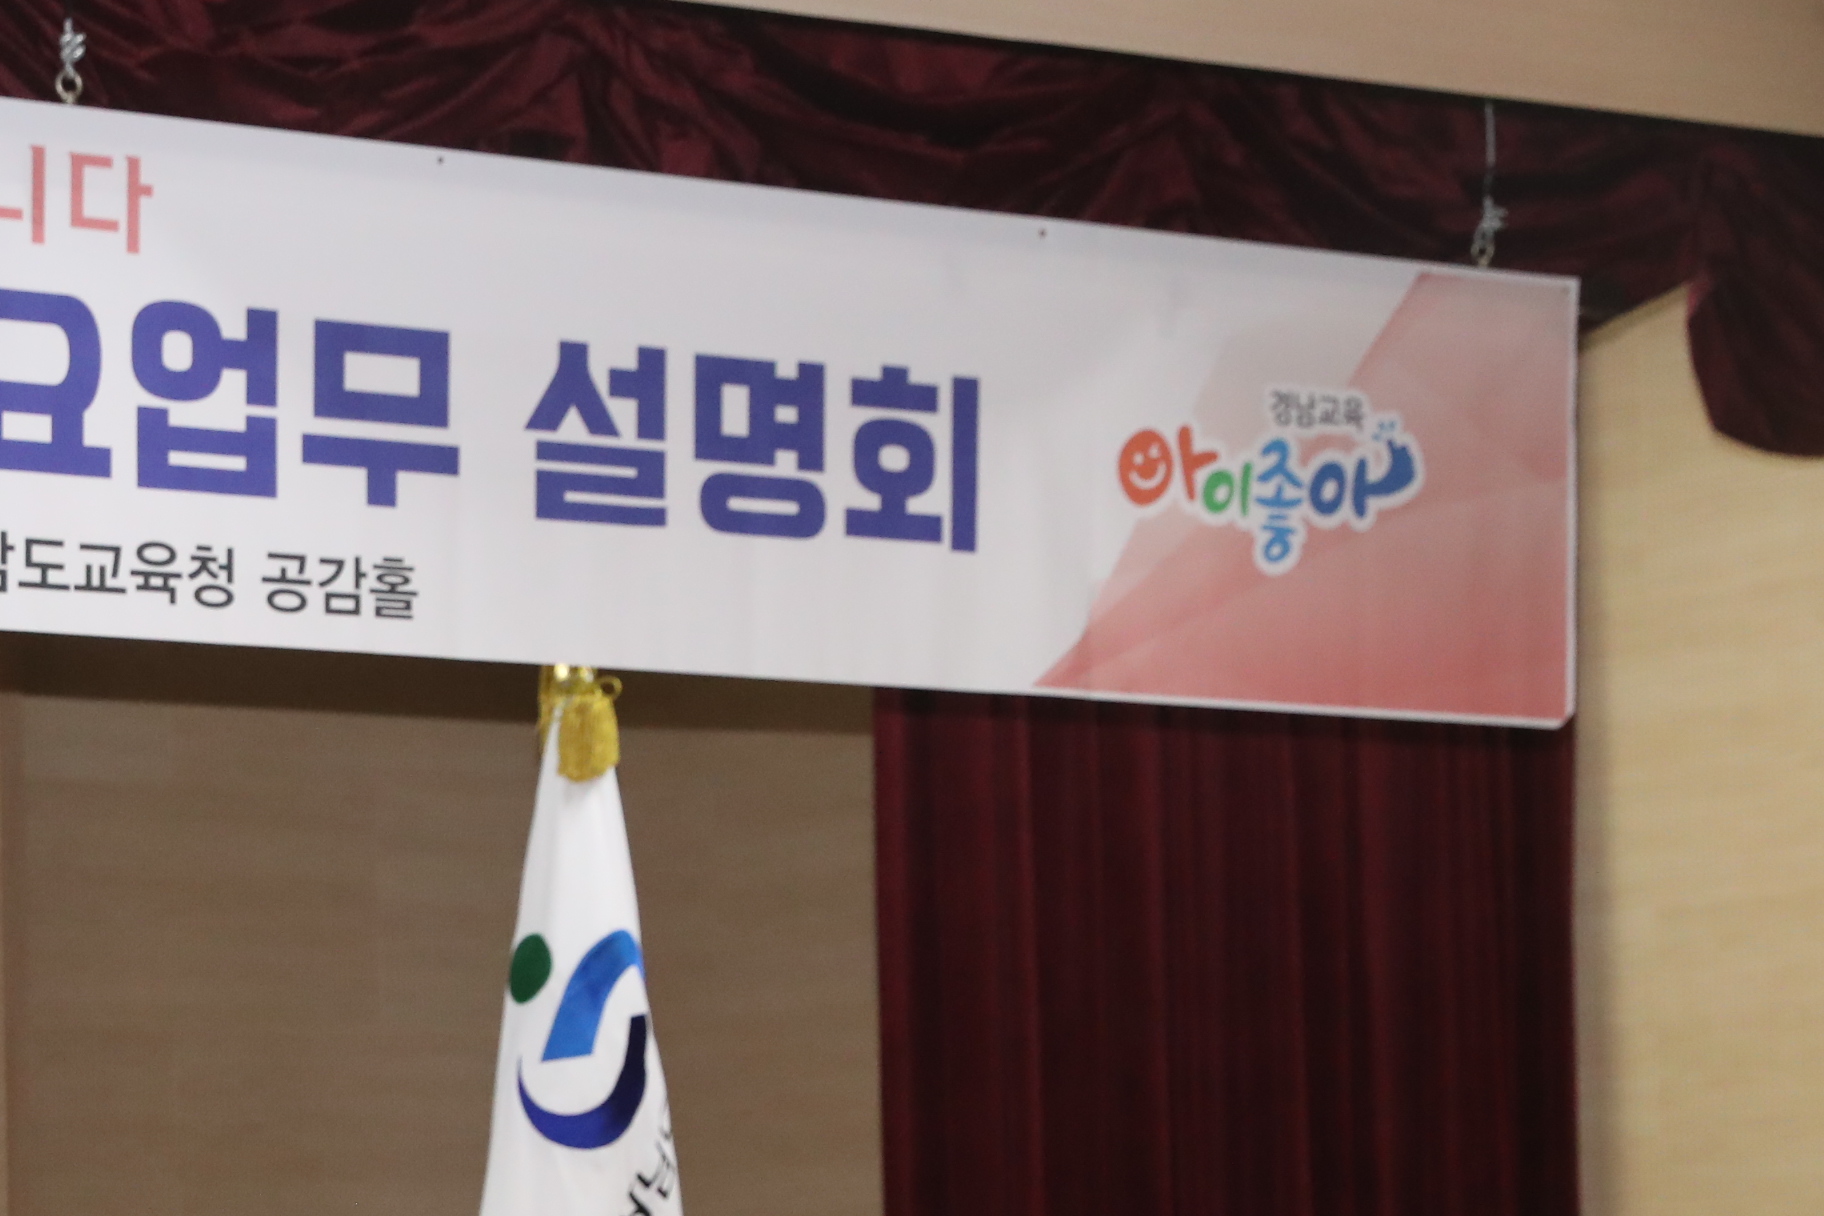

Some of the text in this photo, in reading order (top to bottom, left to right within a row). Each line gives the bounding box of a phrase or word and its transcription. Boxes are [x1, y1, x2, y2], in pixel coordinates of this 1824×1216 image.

[526, 340, 980, 553] 설명회
[1118, 425, 1415, 563] 아이좋아
[260, 553, 418, 620] 공감홀
